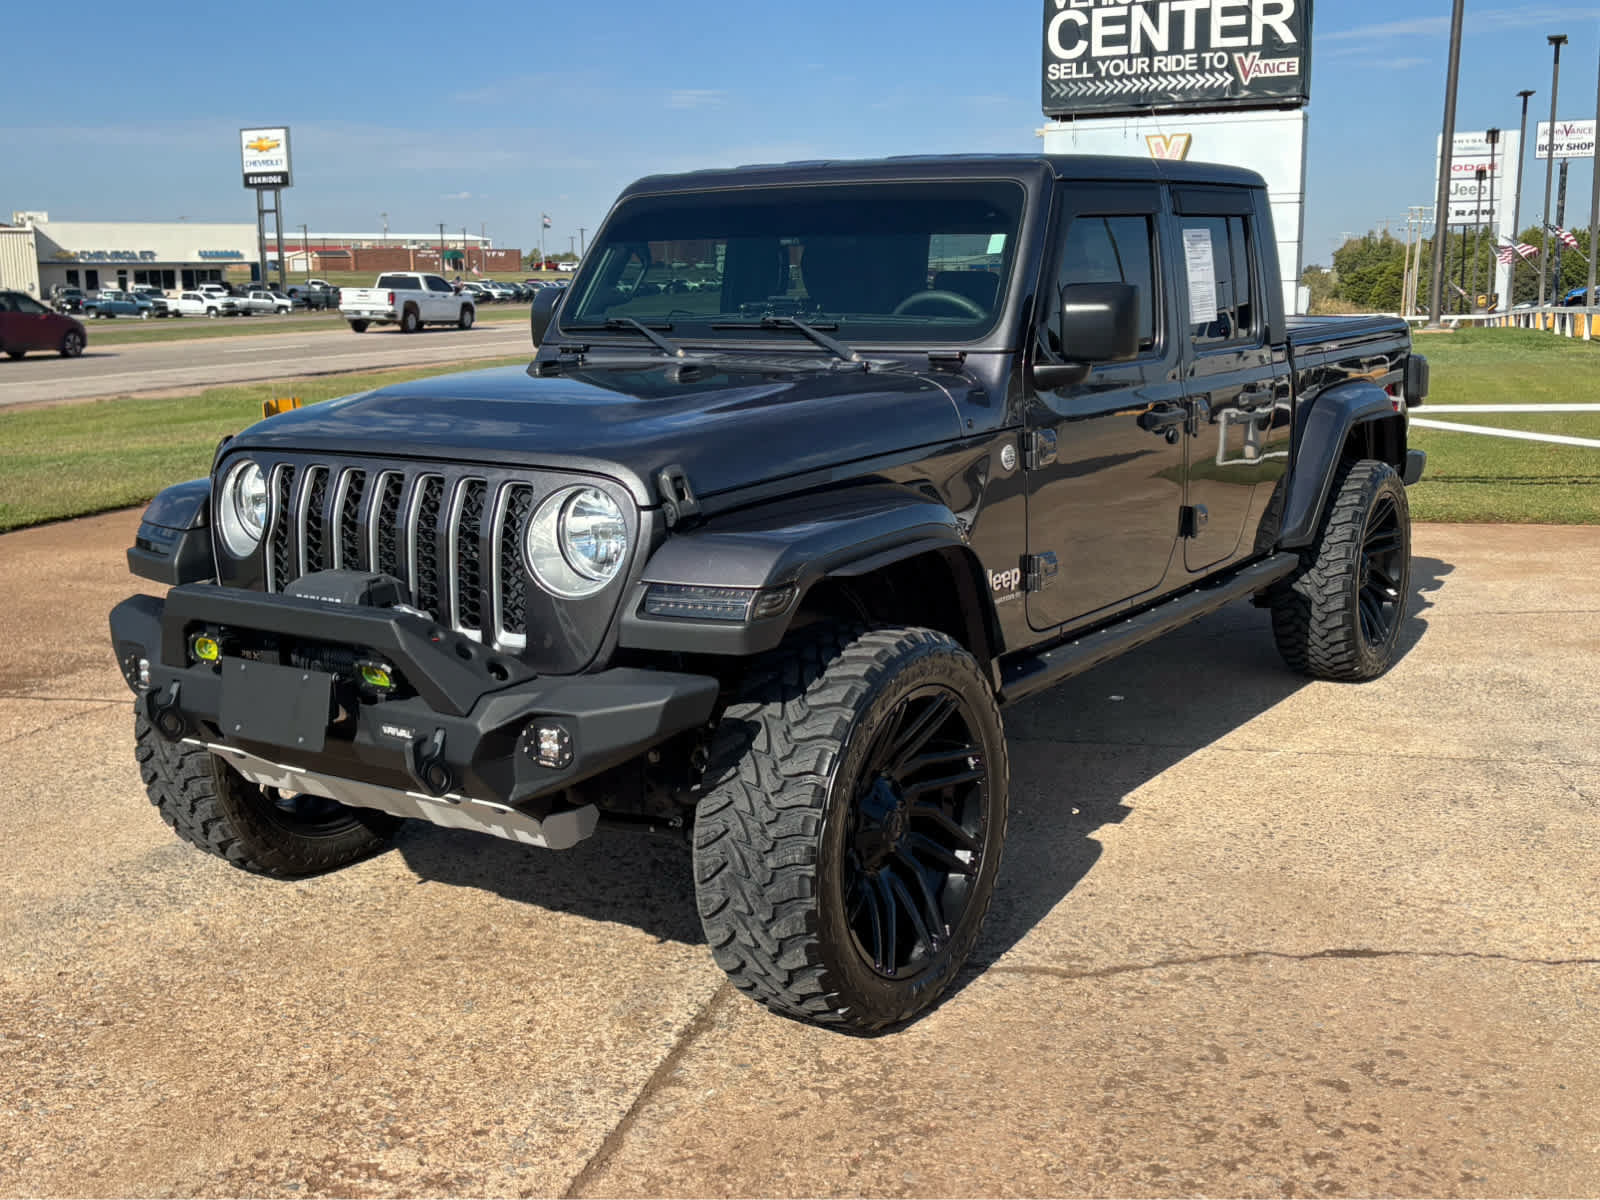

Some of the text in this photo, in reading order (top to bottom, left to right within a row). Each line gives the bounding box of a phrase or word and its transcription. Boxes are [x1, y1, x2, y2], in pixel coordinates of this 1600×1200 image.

[1047, 0, 1297, 59] CENTER
[1047, 52, 1298, 84] SELL YOUR RIDE TO VANCE
[1537, 142, 1594, 152] BODY SHOP
[245, 159, 283, 168] CHEVROLET
[1450, 182, 1487, 197] Jeep
[1455, 208, 1495, 217] RAM
[986, 567, 1021, 591] Jeep
